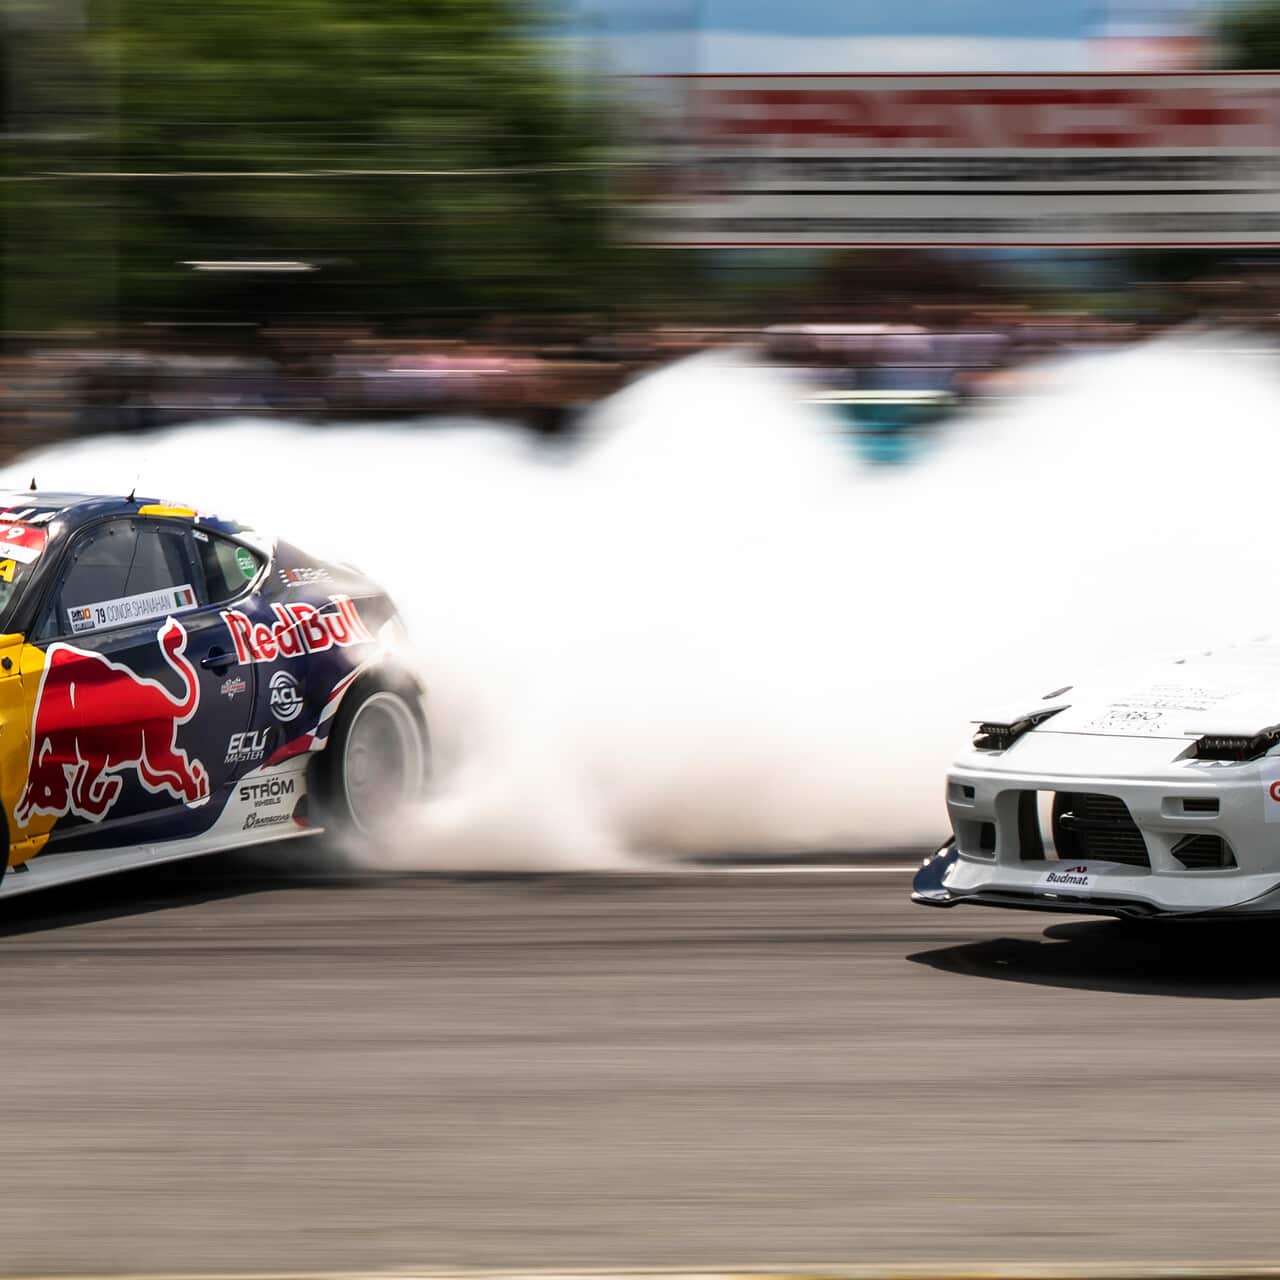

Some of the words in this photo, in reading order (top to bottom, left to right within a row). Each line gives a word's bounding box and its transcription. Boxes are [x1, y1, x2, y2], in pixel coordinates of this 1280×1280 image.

[95, 608, 106, 624] 79
[106, 601, 132, 622] CONOR
[131, 593, 172, 617] SHANAHAN
[220, 602, 307, 665] Red
[287, 595, 375, 654] Bull
[270, 688, 303, 704] ACL
[227, 727, 271, 754] ECU
[224, 751, 265, 764] MASTER
[240, 777, 295, 801] STRÖM
[1047, 871, 1089, 886] Budmat.
